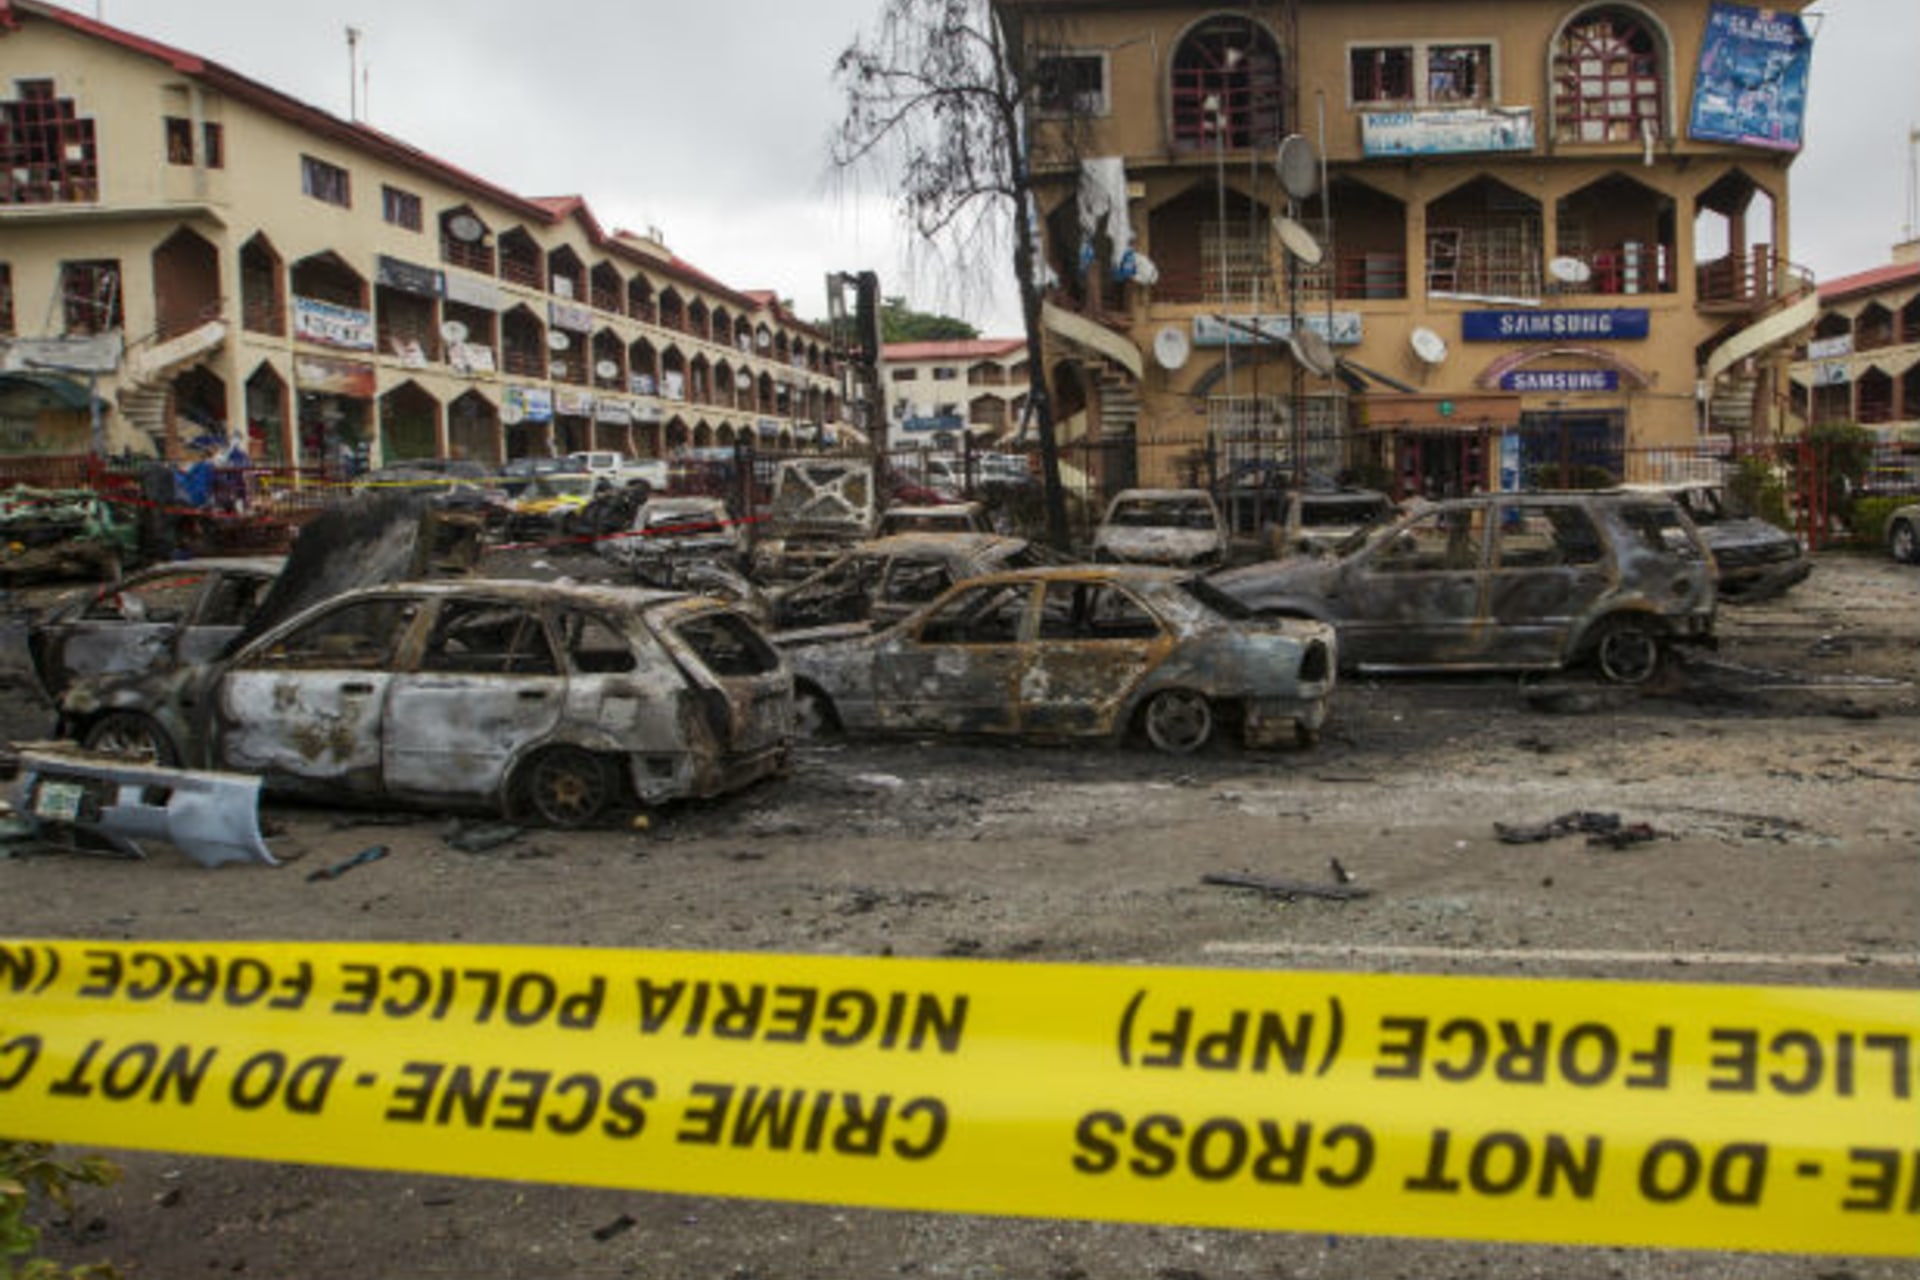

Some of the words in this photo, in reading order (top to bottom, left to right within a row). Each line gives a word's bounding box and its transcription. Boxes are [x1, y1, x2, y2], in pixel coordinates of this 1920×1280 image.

[1500, 314, 1612, 334] SAMSUNG
[1514, 372, 1606, 389] SAMSUNG
[77, 950, 314, 1011] FORCE
[332, 964, 607, 1030] POLICE
[636, 978, 969, 1053] NIGERIA
[1118, 989, 1345, 1077] (NPF)
[1374, 1016, 1674, 1089] FORCE
[1708, 1028, 1911, 1099] LICE
[48, 1039, 218, 1106] NOT
[228, 1050, 342, 1116] DO
[384, 1061, 656, 1140] SCENE
[676, 1083, 948, 1161] CRIME
[1072, 1111, 1376, 1189] CROSS
[1403, 1129, 1603, 1201] NOT
[1637, 1139, 1769, 1208] DO
